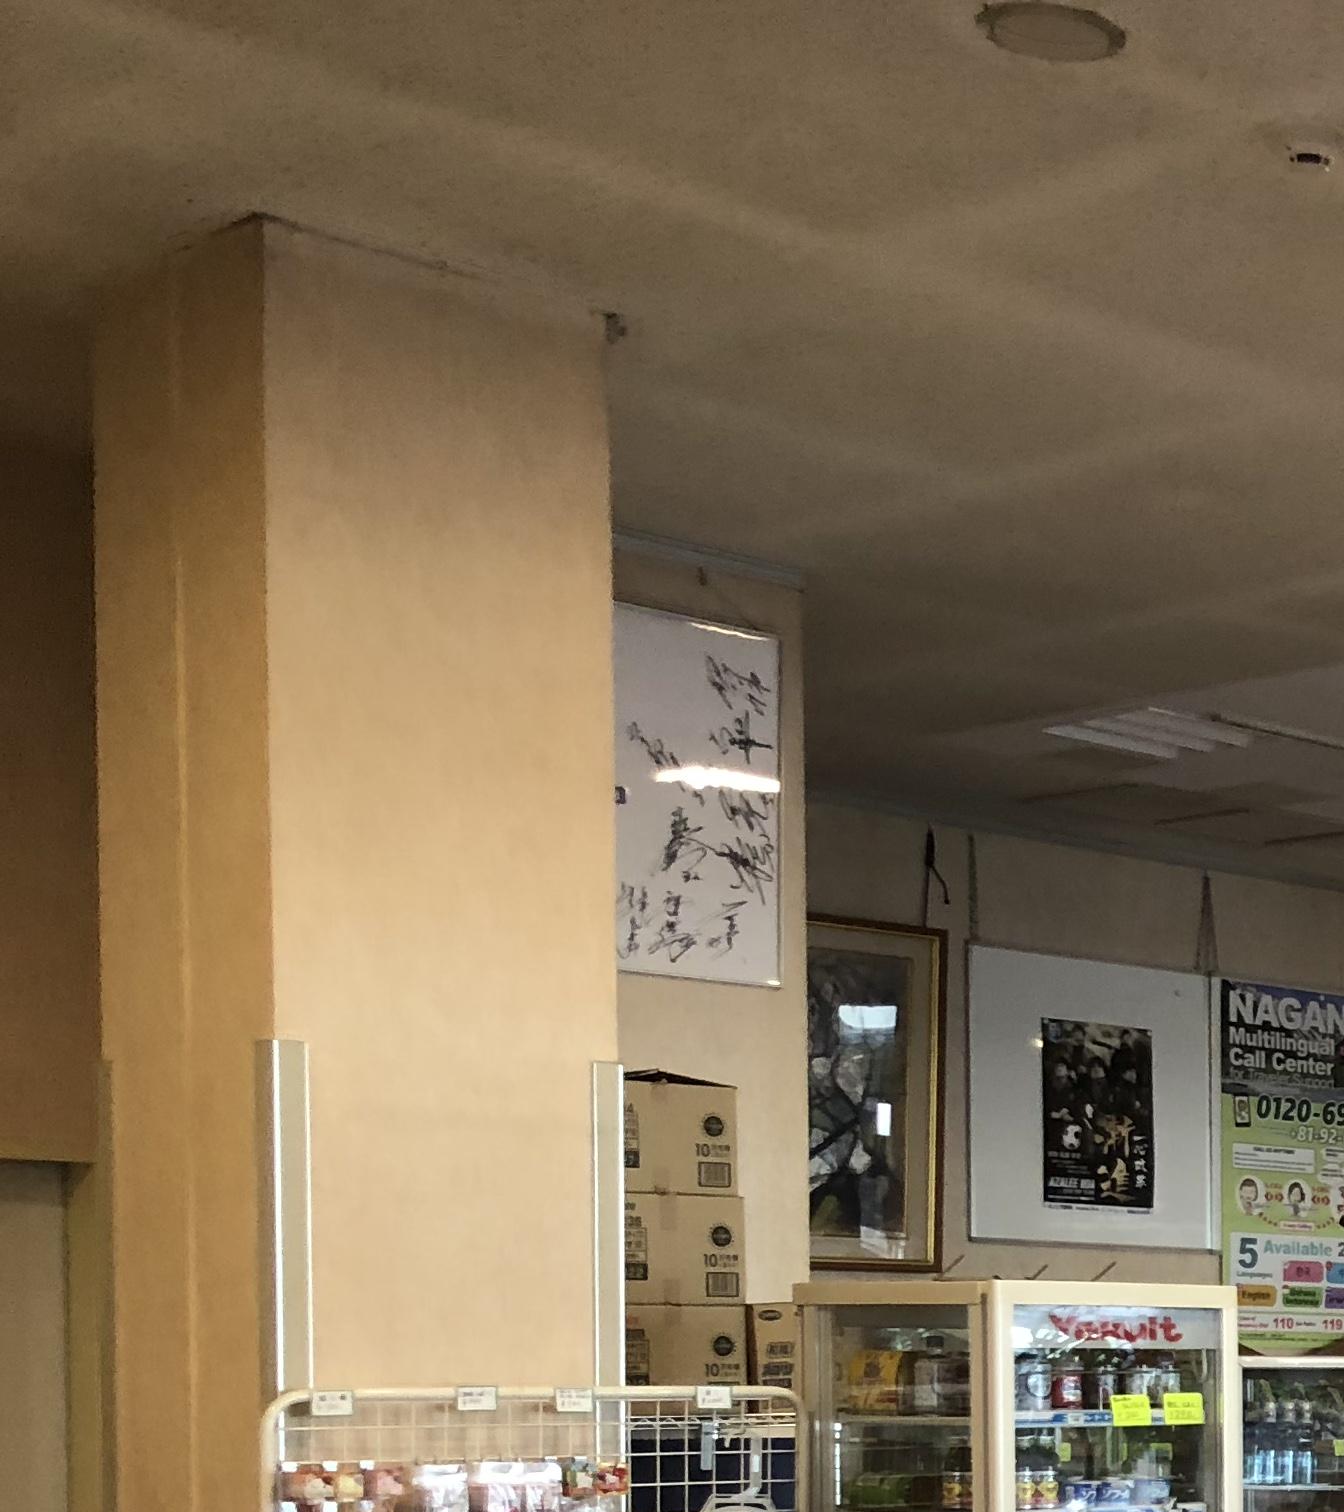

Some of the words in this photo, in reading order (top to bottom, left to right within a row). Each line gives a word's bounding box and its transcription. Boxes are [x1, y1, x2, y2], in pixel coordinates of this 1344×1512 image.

[1229, 1026, 1335, 1057] Multilingual
[1229, 1048, 1266, 1069] Call
[1272, 1053, 1335, 1076] Center
[1238, 1237, 1259, 1269] 5
[1263, 1240, 1332, 1258] Available
